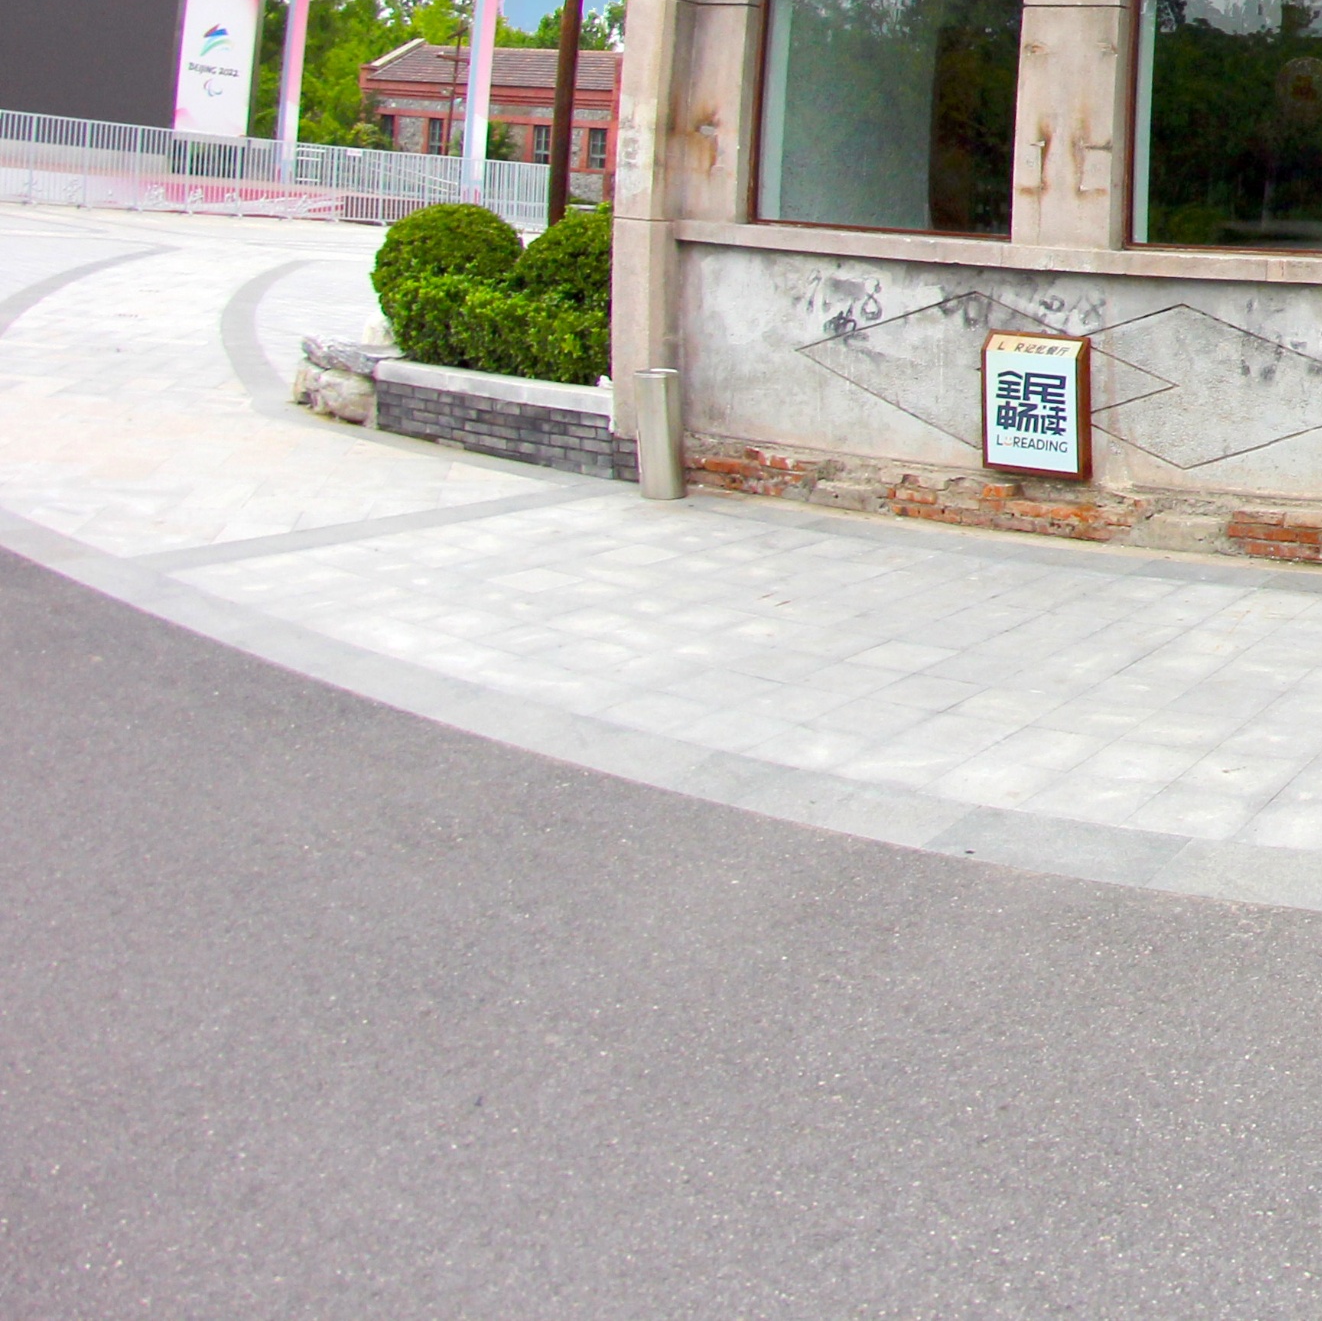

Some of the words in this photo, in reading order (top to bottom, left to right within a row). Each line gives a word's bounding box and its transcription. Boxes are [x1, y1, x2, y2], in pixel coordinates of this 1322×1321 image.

[188, 62, 217, 74] BEIJING
[218, 67, 239, 77] 2022
[996, 370, 1067, 405] 全民
[996, 400, 1067, 436] 畅读
